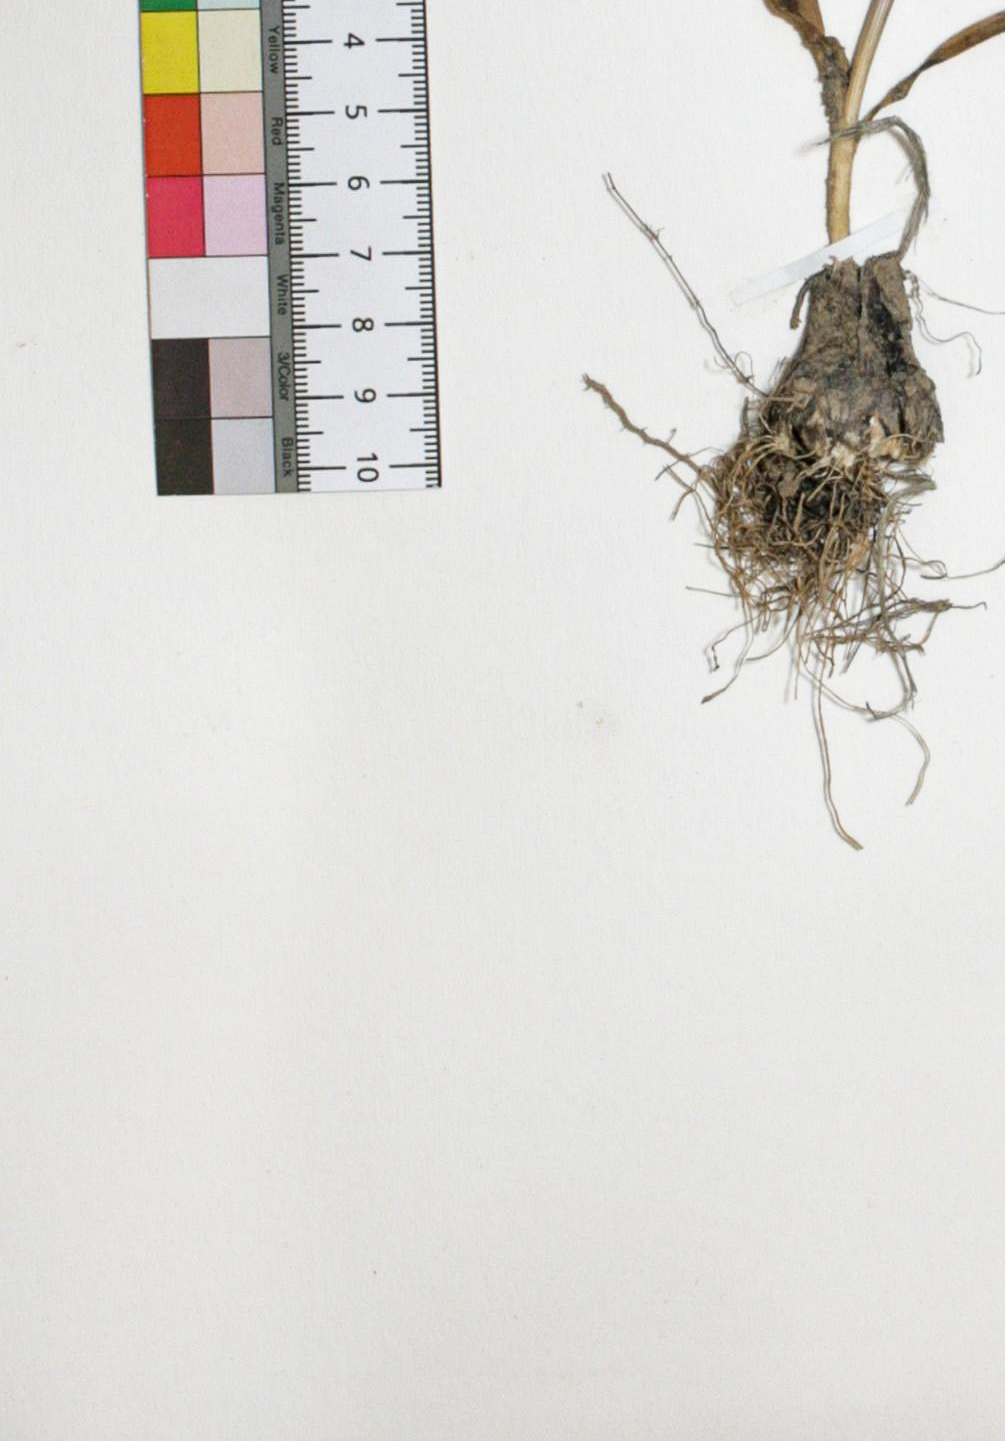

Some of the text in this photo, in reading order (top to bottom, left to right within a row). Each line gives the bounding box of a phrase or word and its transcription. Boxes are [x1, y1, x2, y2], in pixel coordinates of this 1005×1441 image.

[271, 27, 280, 74] Yellow
[343, 32, 365, 50] 4
[345, 105, 368, 120] 5
[272, 116, 285, 145] Red
[347, 175, 370, 191] 6
[272, 182, 285, 245] Magenta
[350, 246, 372, 262] 7
[277, 274, 288, 315] White
[352, 317, 374, 333] 8
[278, 353, 290, 401] 3/Color
[354, 388, 377, 404] 9
[281, 437, 293, 477] Black
[356, 452, 379, 483] 10
